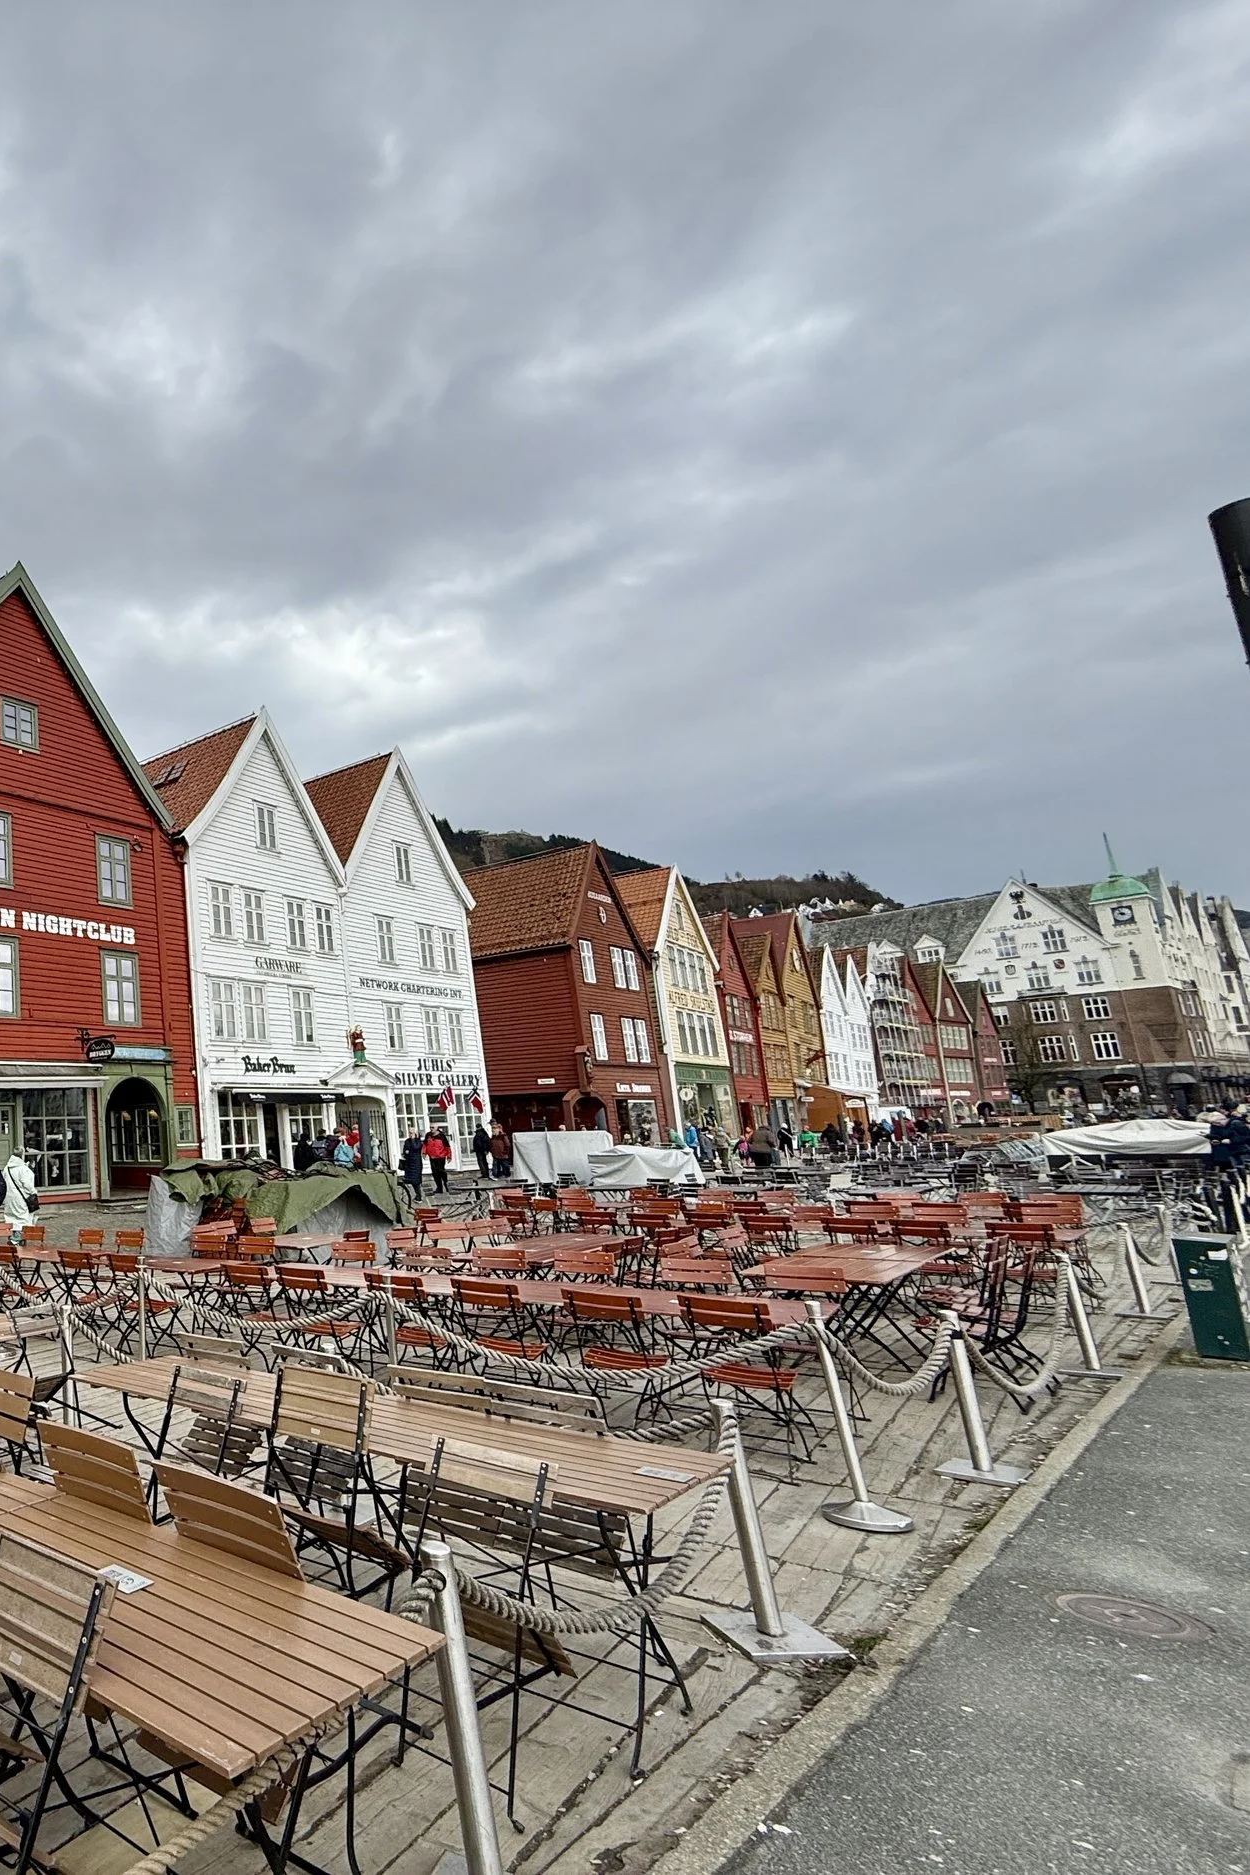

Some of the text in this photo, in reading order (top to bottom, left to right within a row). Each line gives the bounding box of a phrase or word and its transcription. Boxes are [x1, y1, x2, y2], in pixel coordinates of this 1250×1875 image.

[22, 911, 136, 945] NIGHTCLUB
[255, 956, 302, 974] GARWARE
[359, 977, 400, 992] NETWORK
[400, 983, 449, 998] CHARTERING
[395, 1072, 481, 1087] SILVER GALLERY
